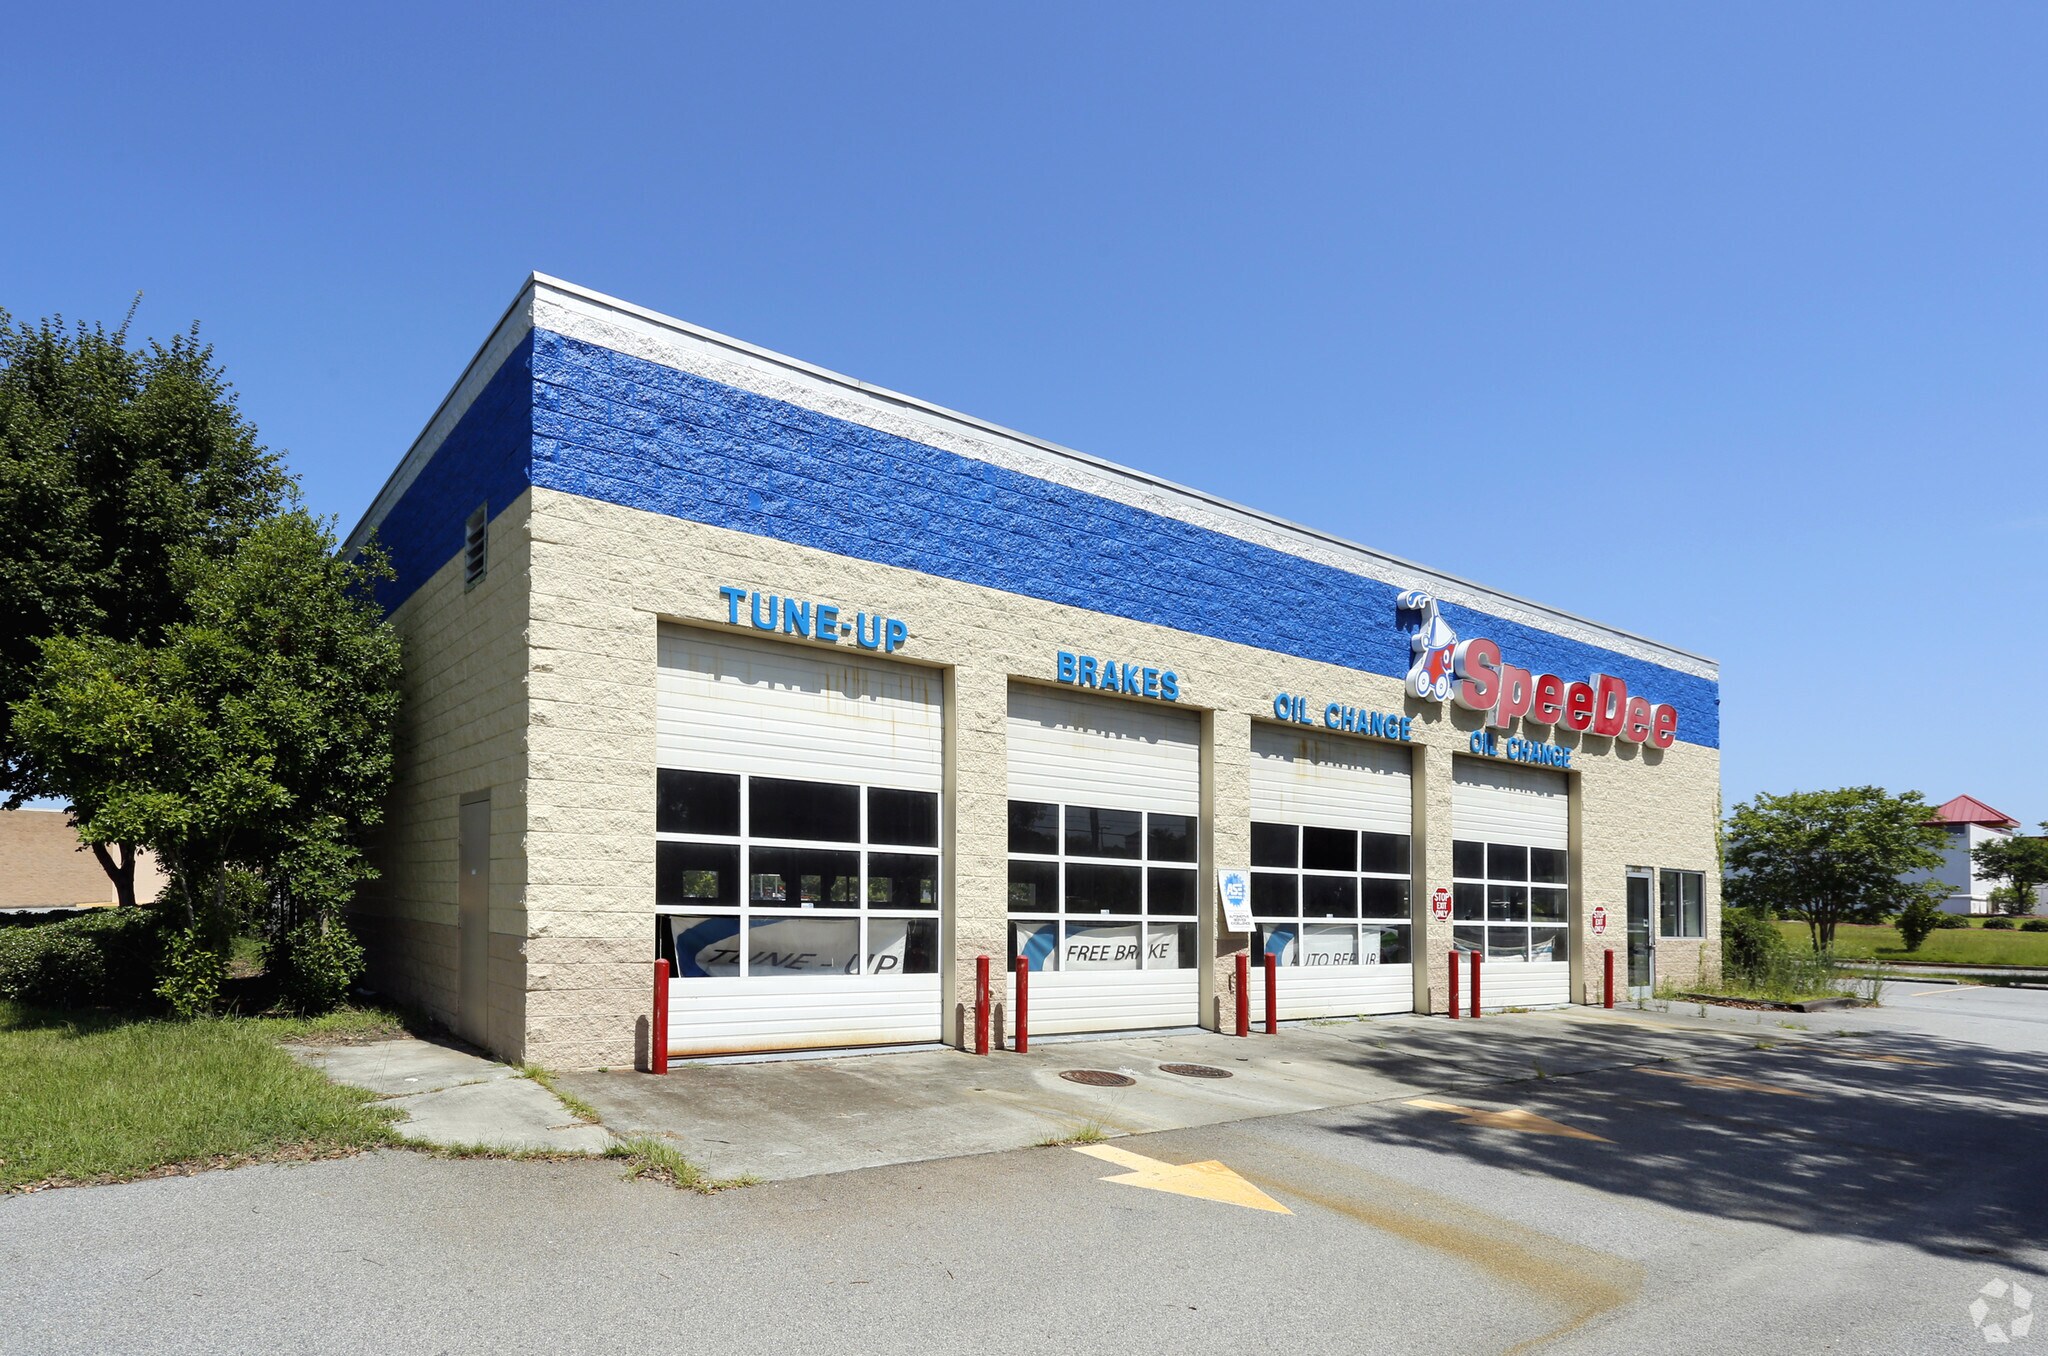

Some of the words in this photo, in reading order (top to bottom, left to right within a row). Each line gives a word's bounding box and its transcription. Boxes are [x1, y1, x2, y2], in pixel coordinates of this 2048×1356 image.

[720, 586, 908, 653] TUNE-UP
[1057, 650, 1180, 701] BRAKES
[1452, 638, 1678, 750] SpeeDee
[1274, 693, 1313, 725] OIL
[1324, 702, 1413, 741] CHANGE
[1470, 730, 1498, 757] OIL
[1507, 737, 1573, 769] CHANGE
[1226, 883, 1243, 896] ASE
[1434, 892, 1450, 901] STOP
[1436, 901, 1447, 909] EXIT
[1435, 909, 1448, 918] ONLY
[1593, 910, 1605, 918] STOP
[1066, 945, 1111, 961] FREE
[1332, 953, 1376, 965] REPIR
[707, 949, 816, 970] TUNE
[844, 953, 898, 975] UP
